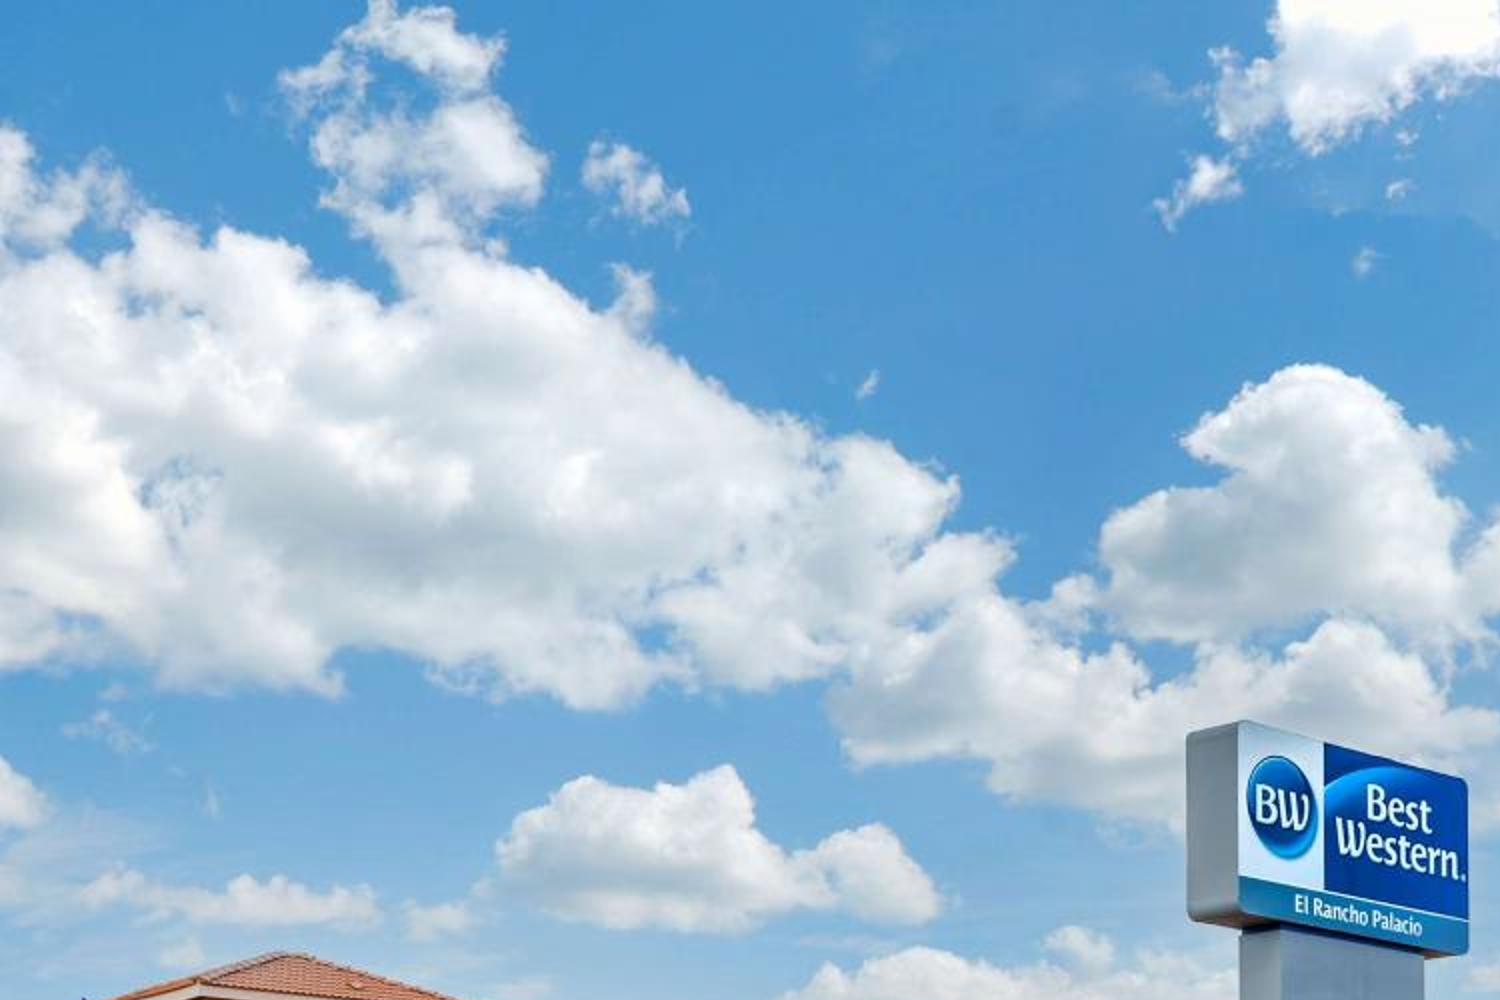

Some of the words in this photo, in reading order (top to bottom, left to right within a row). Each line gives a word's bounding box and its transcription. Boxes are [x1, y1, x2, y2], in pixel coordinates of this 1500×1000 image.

[1255, 783, 1309, 831] BW
[1367, 783, 1432, 834] Best
[1295, 893, 1309, 915] El
[1313, 897, 1369, 926] Rancho
[1371, 909, 1423, 937] Palacio
